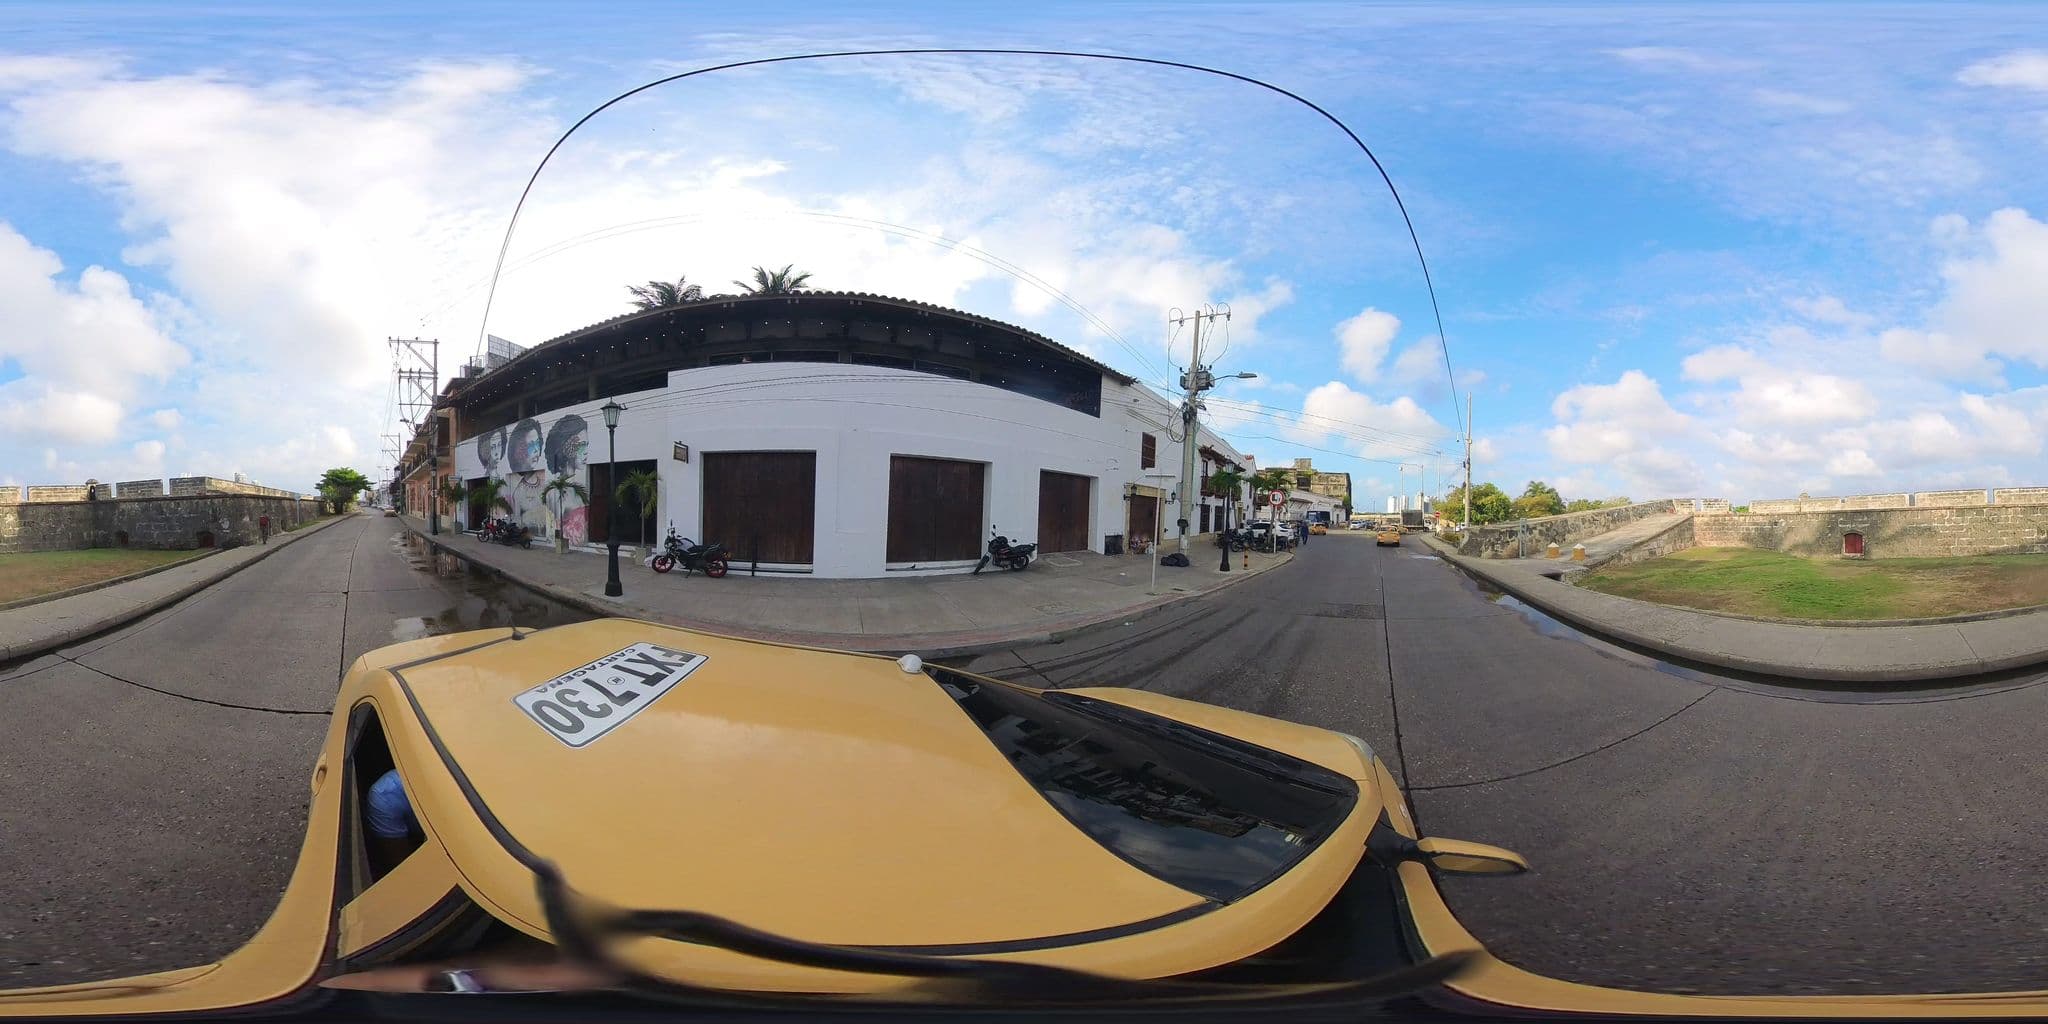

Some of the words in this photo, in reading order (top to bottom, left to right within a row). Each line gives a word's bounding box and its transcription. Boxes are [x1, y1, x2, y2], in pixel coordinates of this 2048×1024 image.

[535, 648, 636, 693] CARTAGENA
[612, 646, 697, 687] FXT
[531, 678, 641, 734] 730
